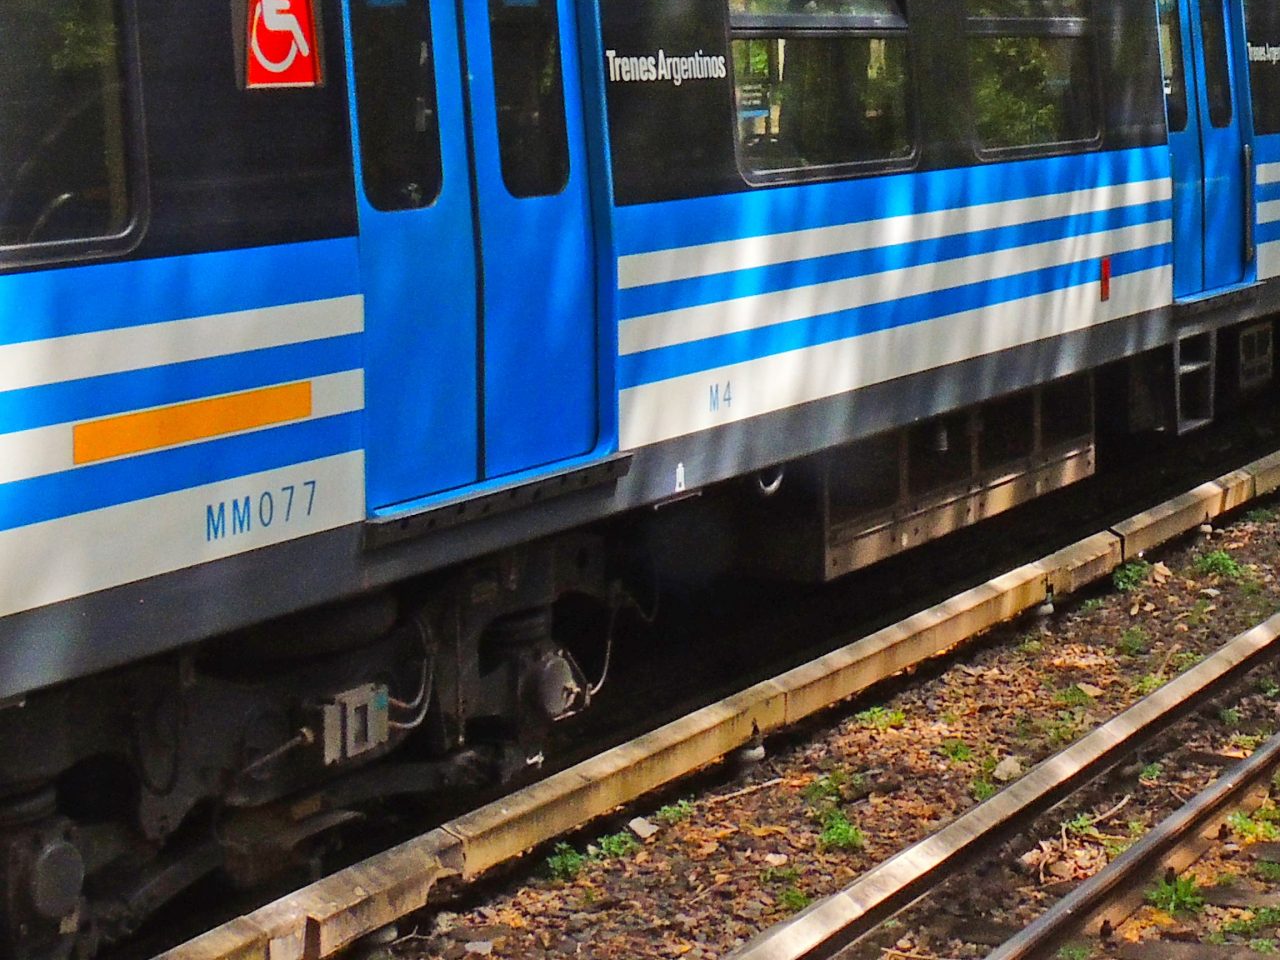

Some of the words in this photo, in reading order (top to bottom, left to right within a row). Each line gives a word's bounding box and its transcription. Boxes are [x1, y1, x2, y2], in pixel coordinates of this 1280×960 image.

[605, 49, 657, 82] Trenes
[657, 48, 727, 86] Argentinos
[206, 480, 316, 542] MM077
